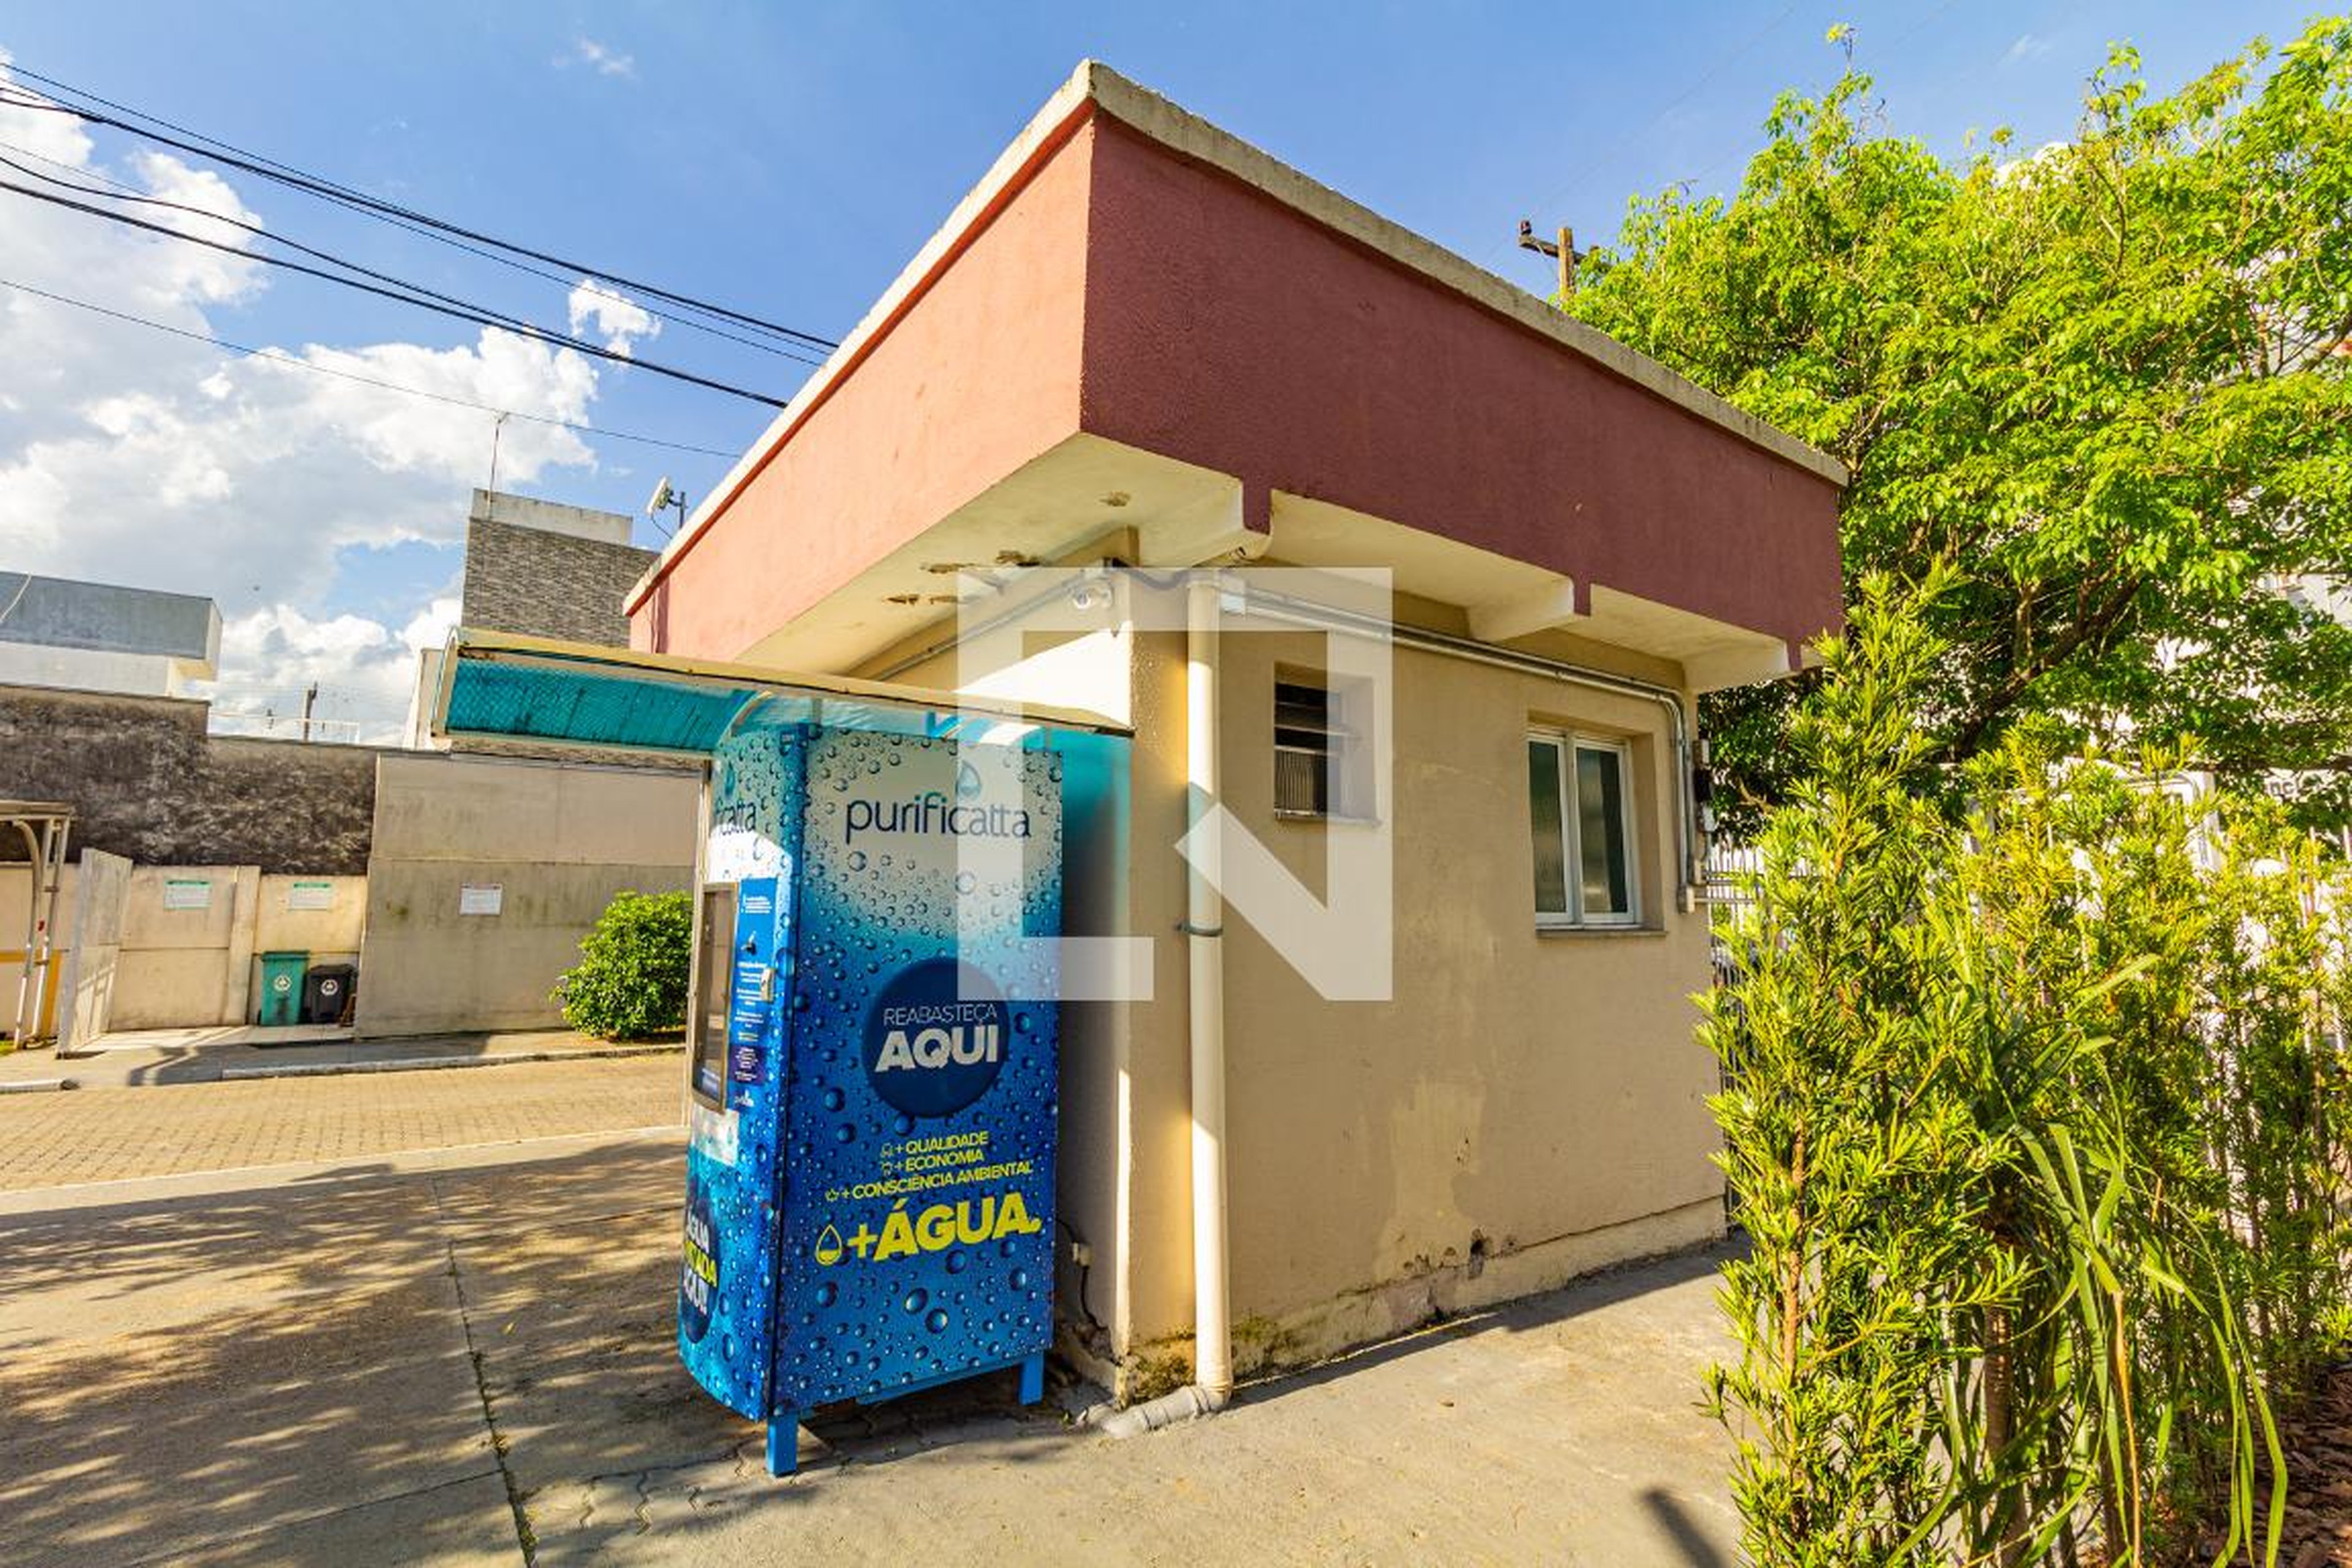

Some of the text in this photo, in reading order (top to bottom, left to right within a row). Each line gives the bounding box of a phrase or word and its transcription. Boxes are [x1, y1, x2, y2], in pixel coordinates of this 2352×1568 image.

[846, 792, 1031, 845] purificatta
[883, 1003, 998, 1026] REABASTEÇA
[875, 1024, 998, 1072] AQUI
[956, 1161, 1033, 1185] AMBIENTAL
